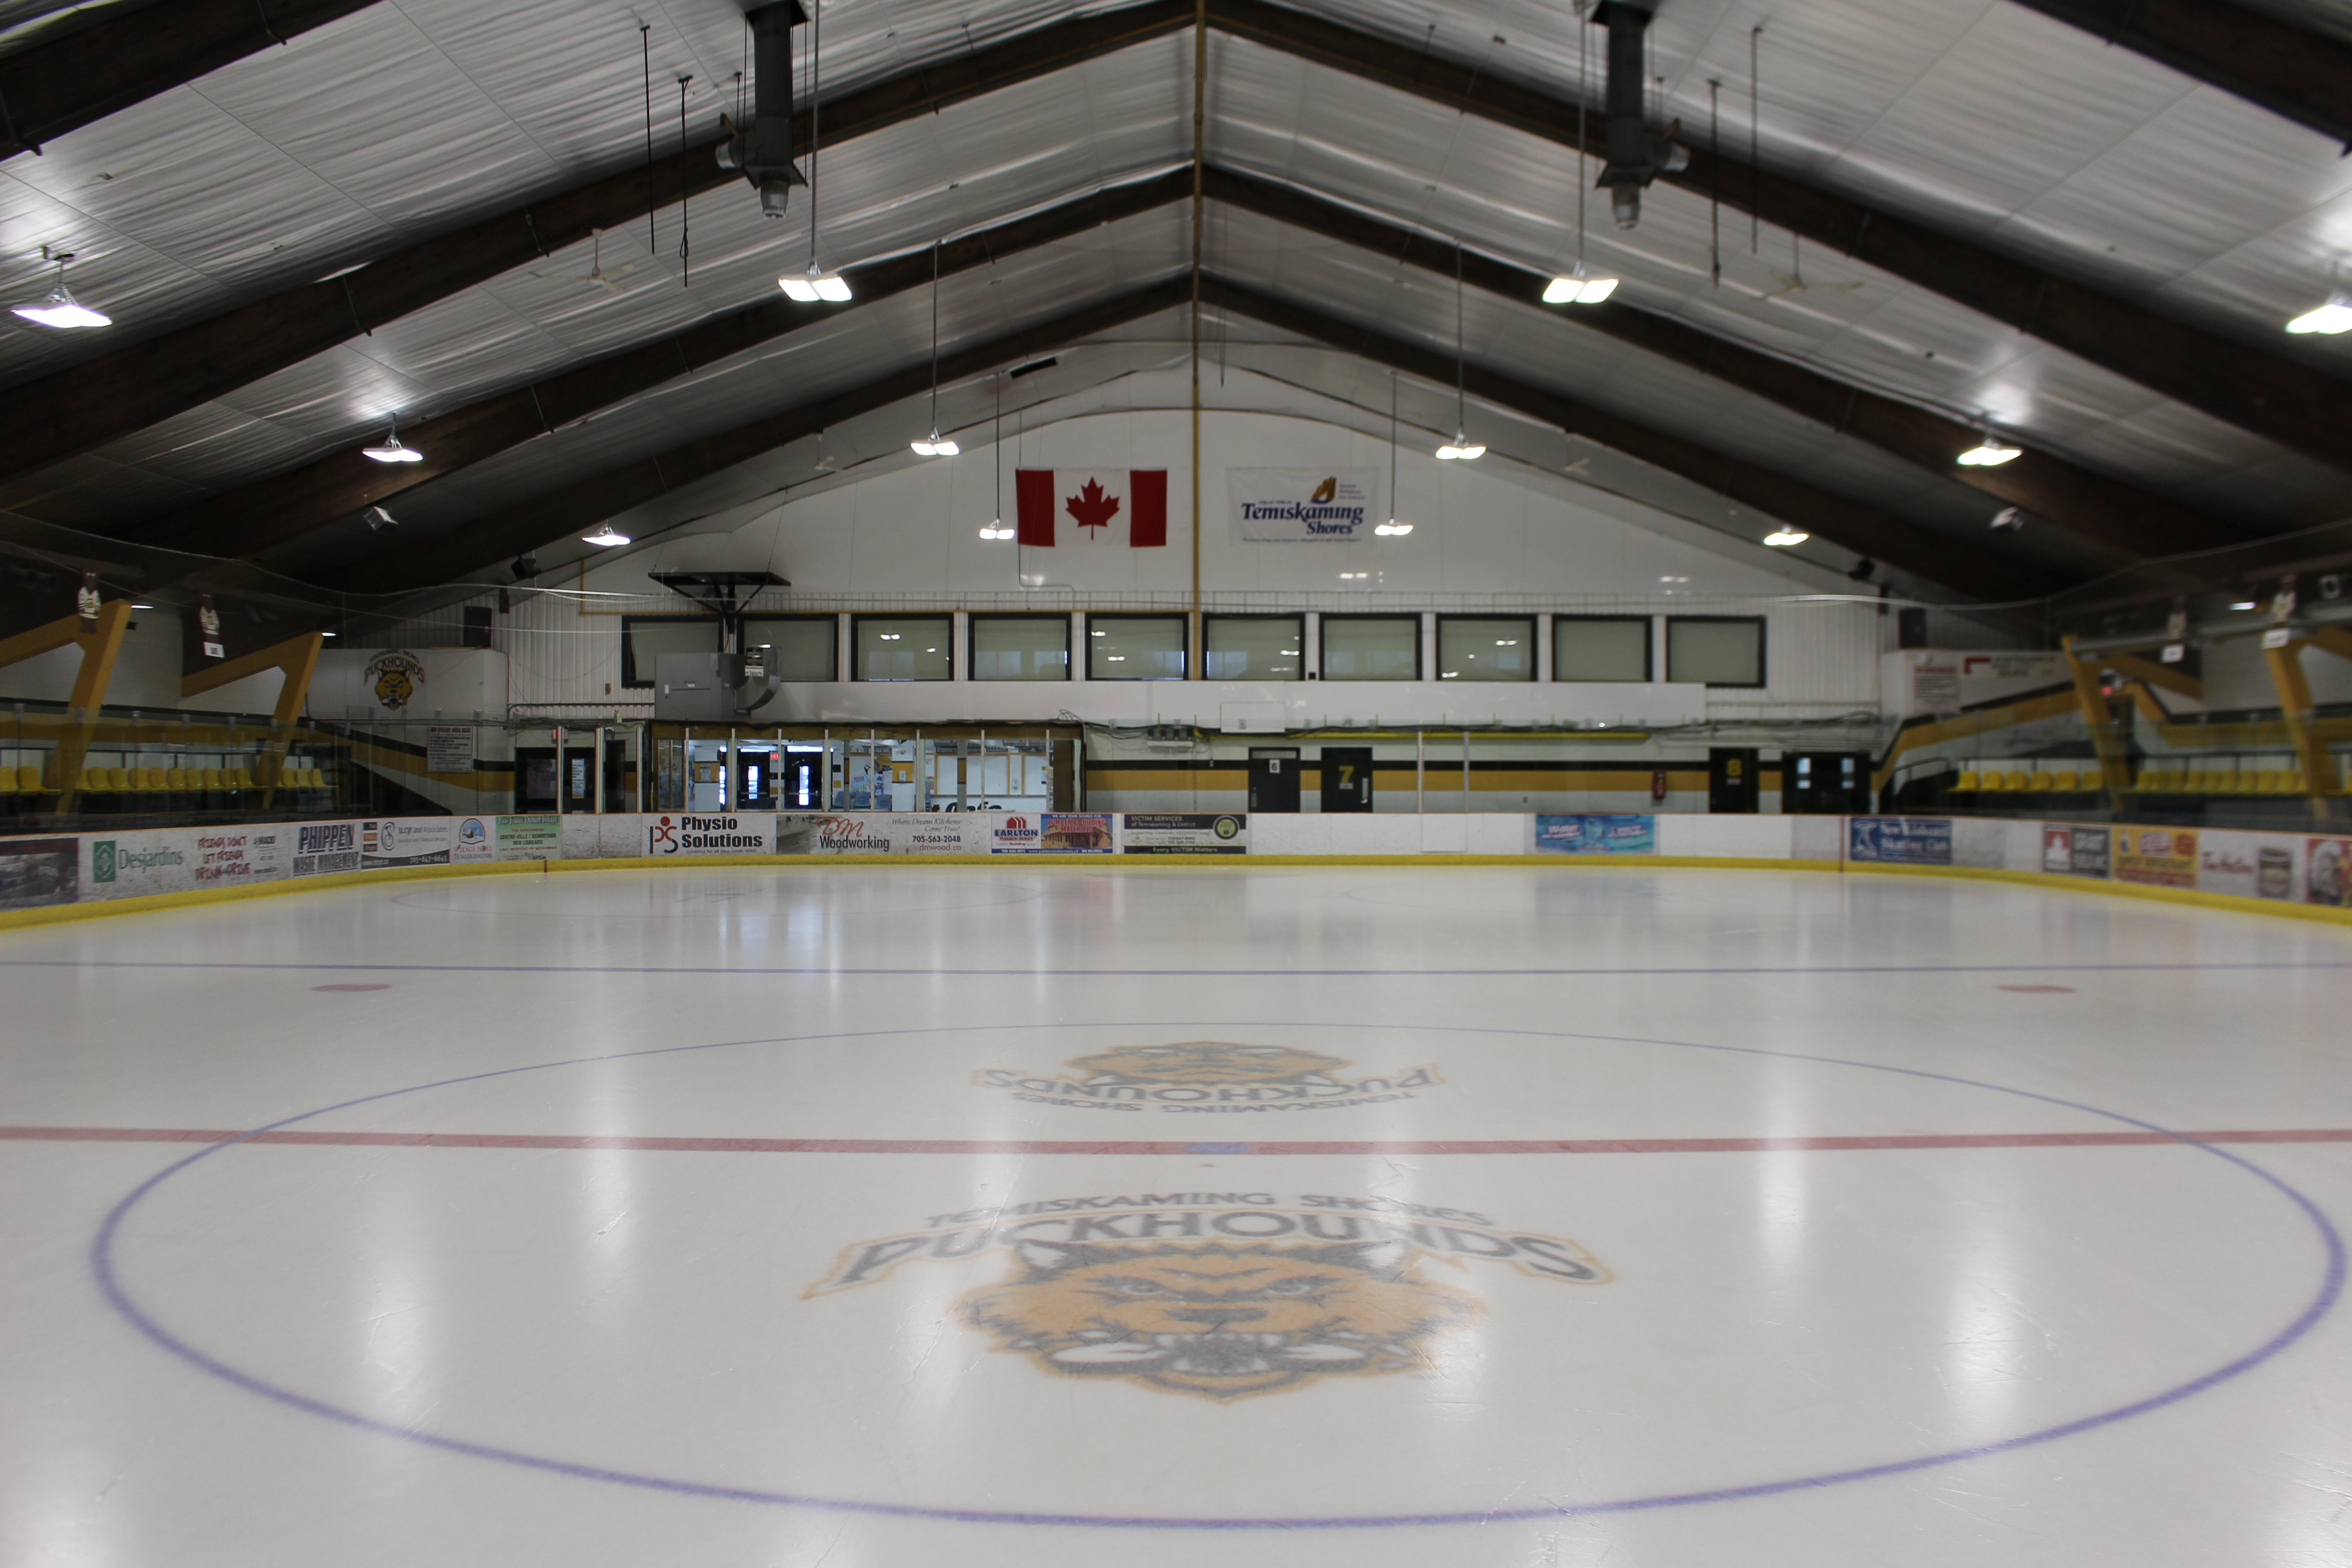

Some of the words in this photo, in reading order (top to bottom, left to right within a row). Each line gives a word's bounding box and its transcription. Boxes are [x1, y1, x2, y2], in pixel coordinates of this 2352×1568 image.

[1241, 501, 1364, 524] Temiskaming
[1307, 521, 1352, 534] Shores
[364, 657, 425, 683] PUCKHOUNDS
[1339, 765, 1354, 784] 7
[1727, 758, 1742, 776] 8
[681, 817, 737, 834] Physio
[816, 816, 864, 837] DM
[298, 823, 355, 854] PHIPPEN
[453, 844, 476, 853] VILLAGE
[682, 834, 763, 848] Solutions
[819, 835, 889, 853] Woodworking
[117, 846, 183, 874] Desjardins
[293, 855, 316, 877] WASTE
[983, 1068, 1433, 1101] PUCKHOUNDS
[1012, 1092, 1143, 1112] SHORES
[1161, 1091, 1417, 1113] TEMISKAMING
[926, 1193, 1275, 1228] TEMISKAMING
[1299, 1194, 1493, 1226] SHORES
[832, 1210, 1597, 1286] PUCKHOUNDS
